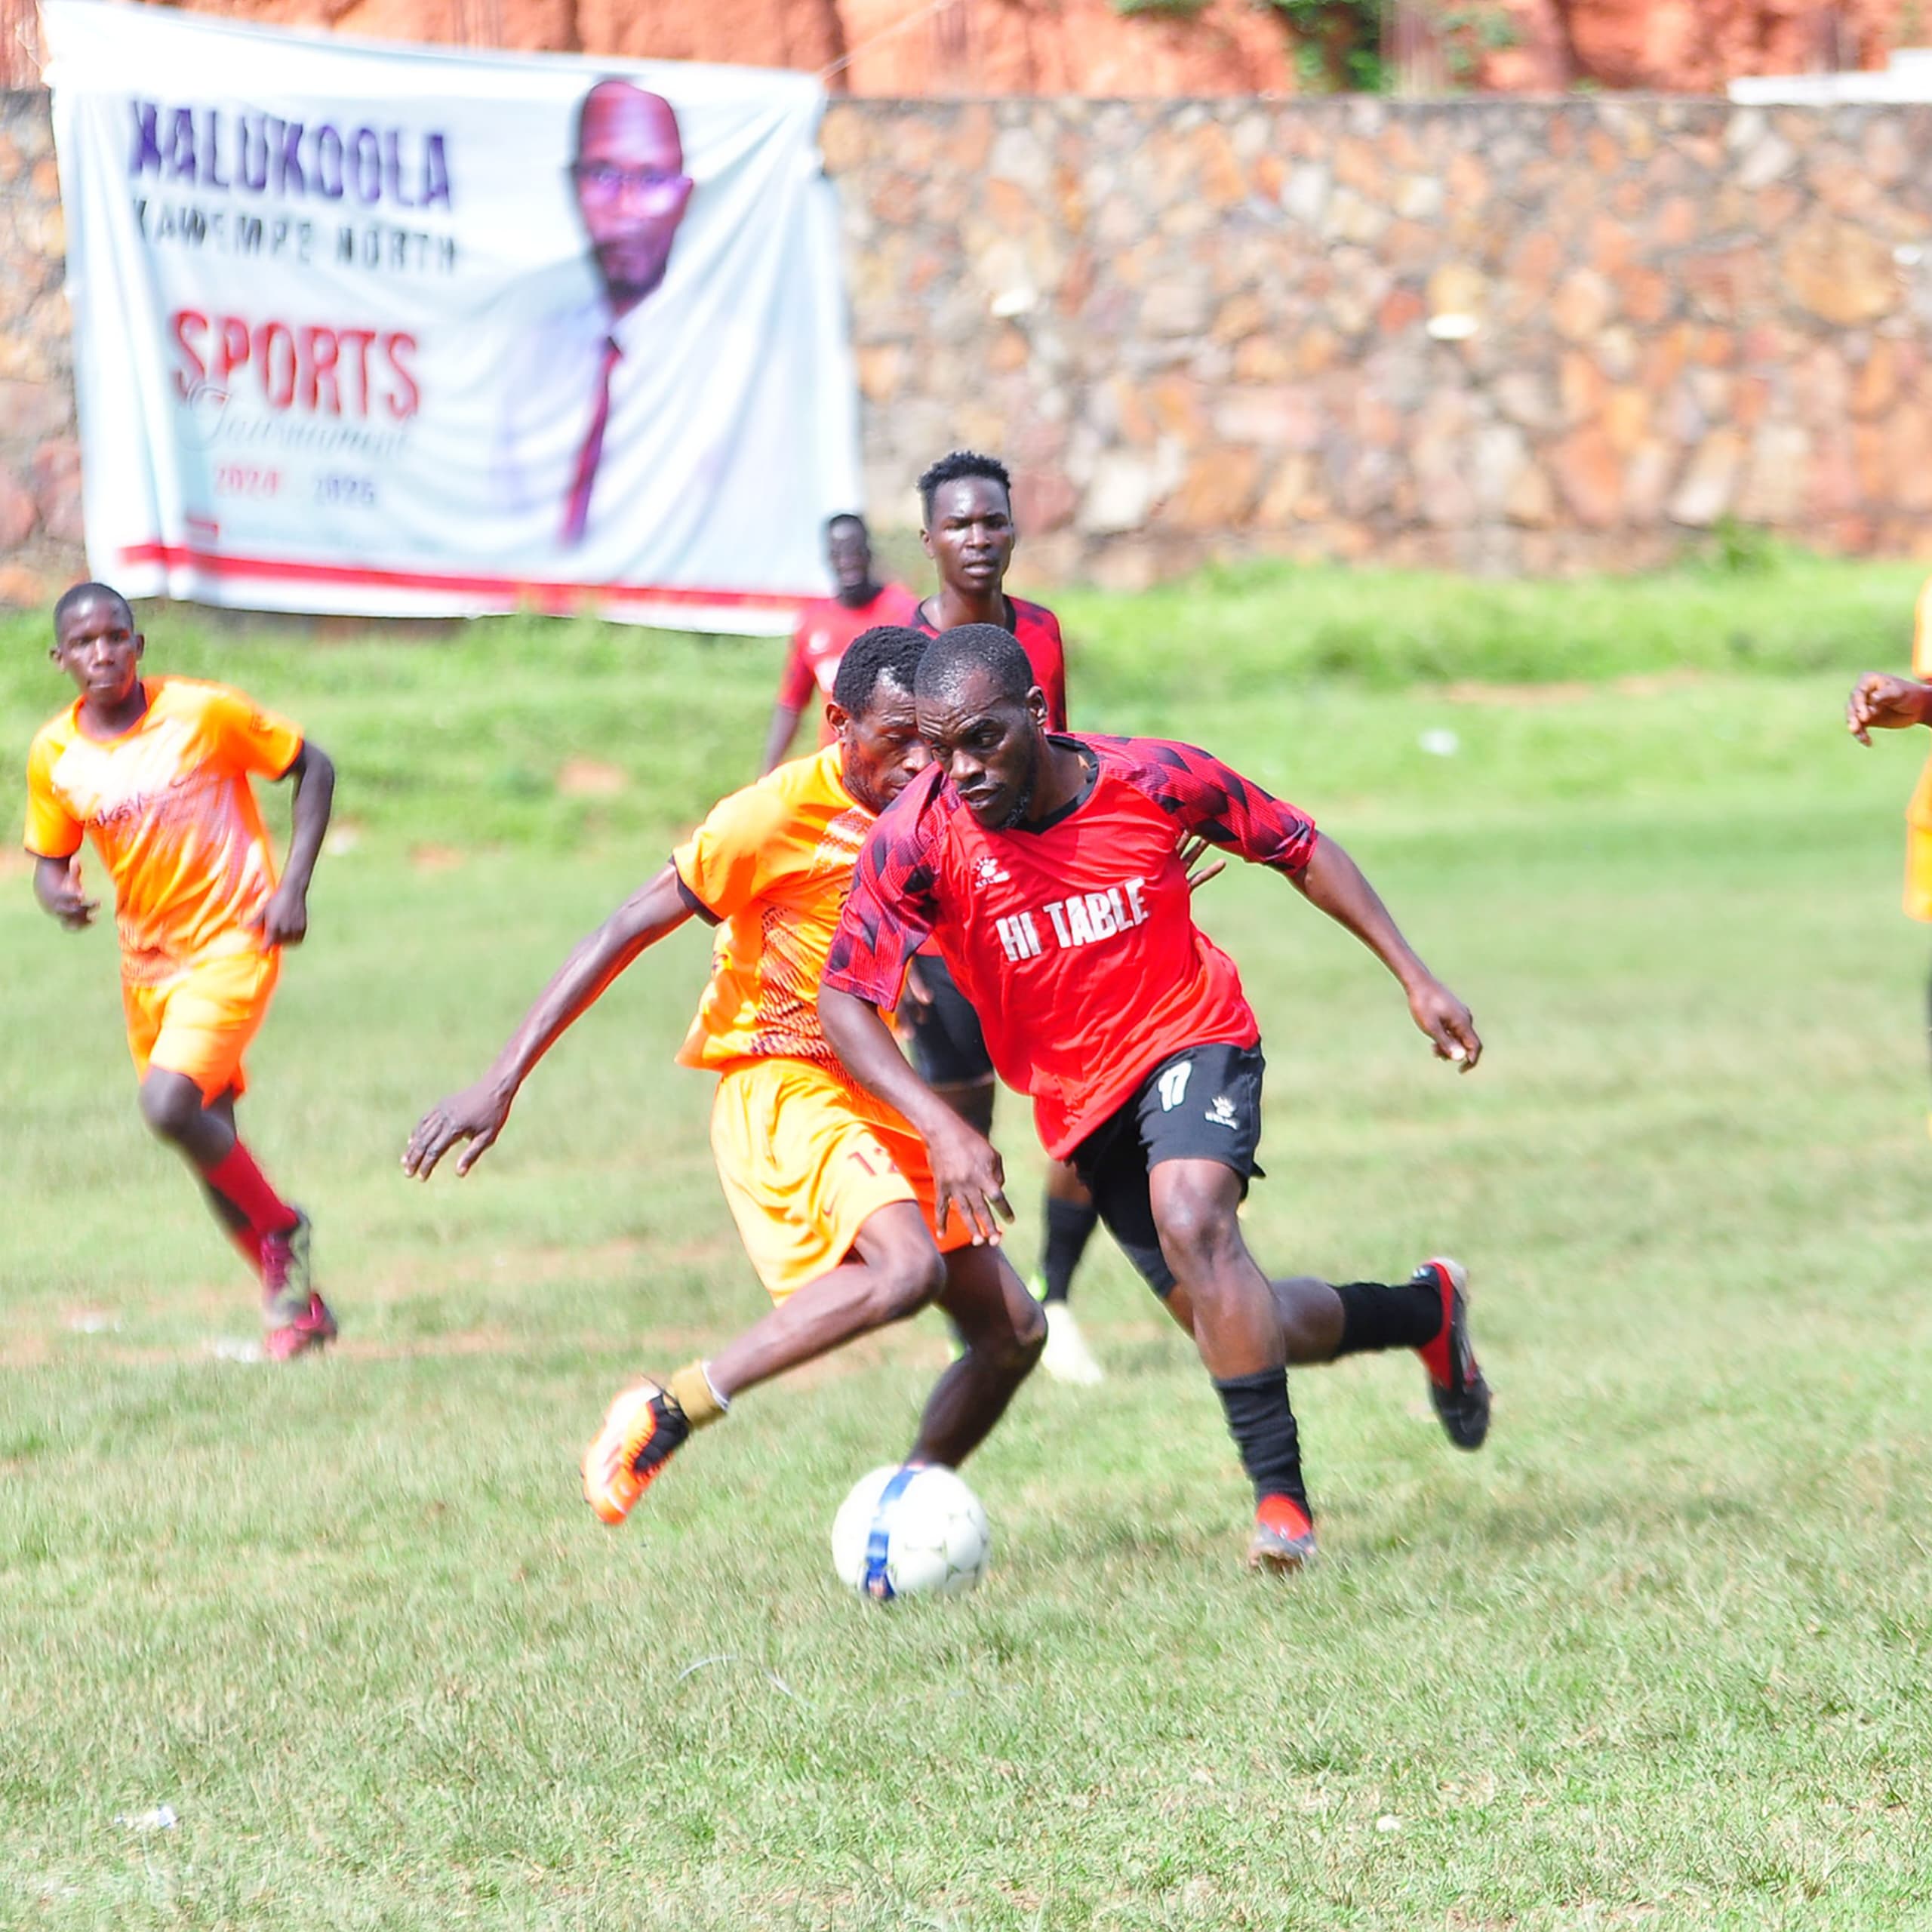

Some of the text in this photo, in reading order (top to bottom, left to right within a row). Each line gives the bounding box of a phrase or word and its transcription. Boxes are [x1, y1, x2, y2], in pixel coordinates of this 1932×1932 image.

[337, 223, 456, 273] NORTH
[172, 309, 421, 420] SPORTS
[995, 876, 1151, 962] HI TABLE
[1158, 1060, 1192, 1112] 17
